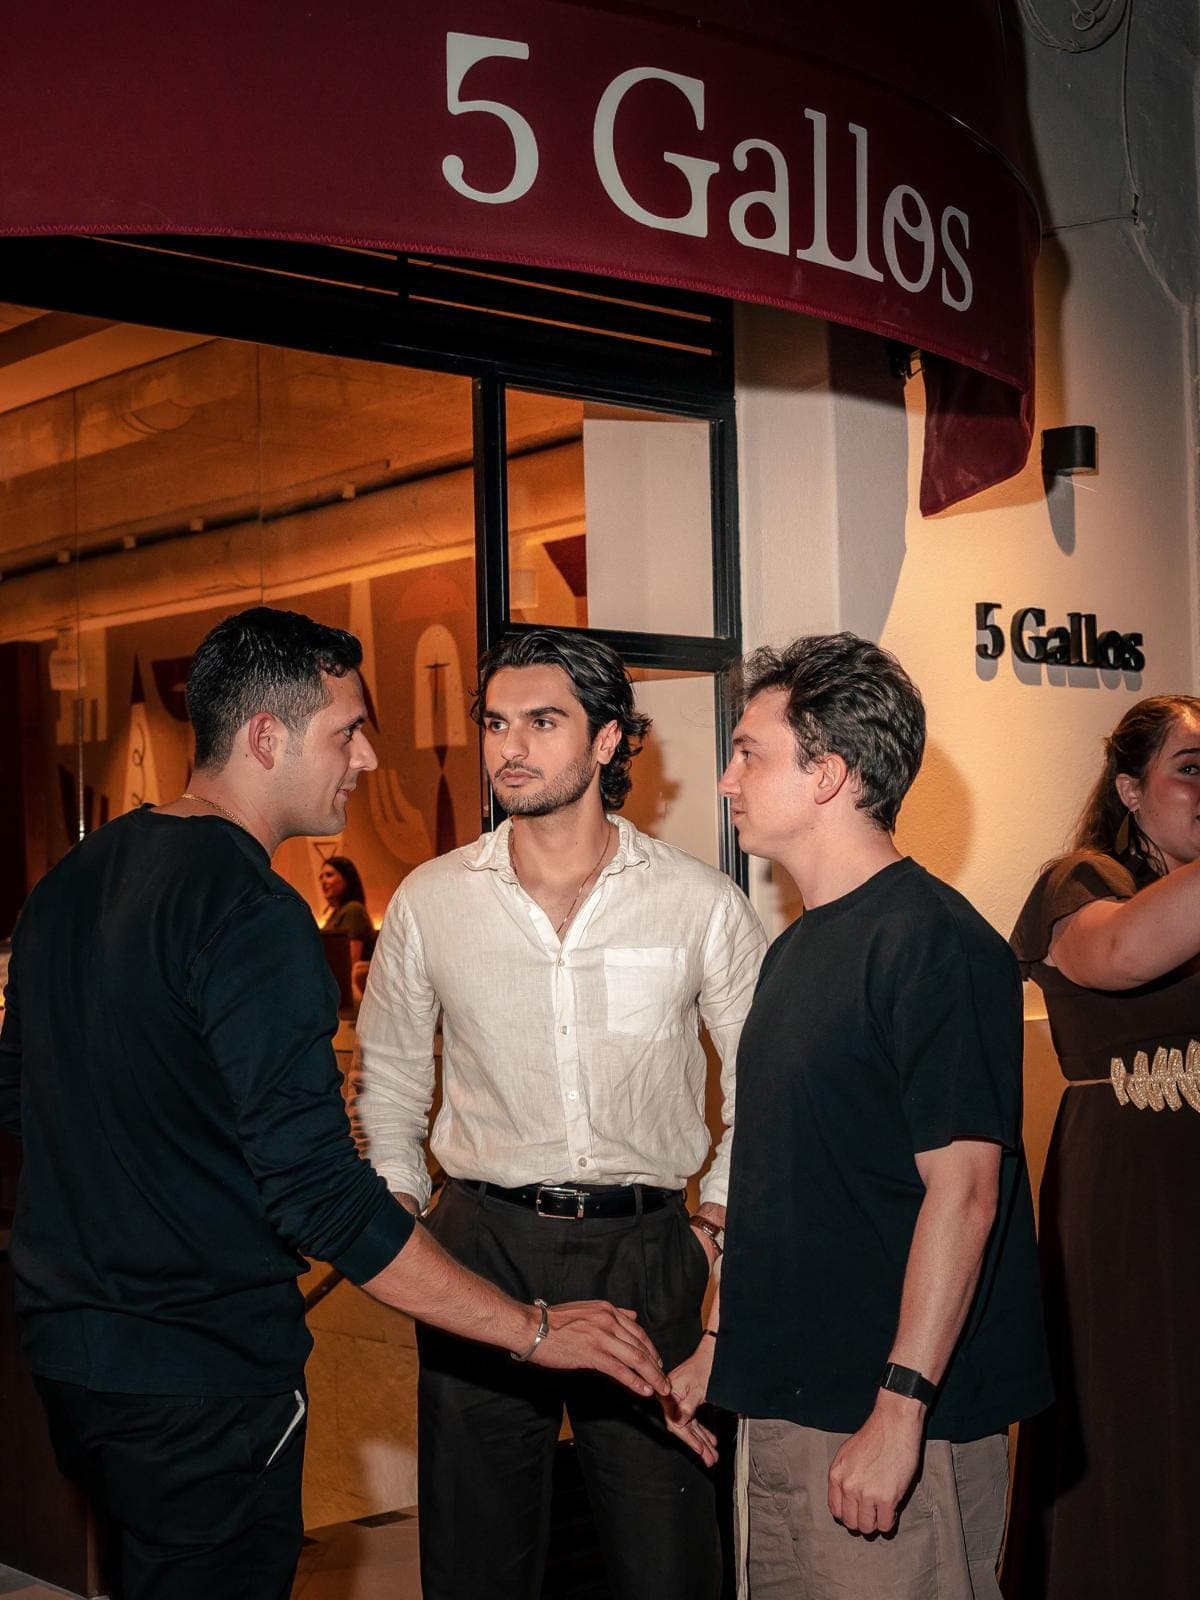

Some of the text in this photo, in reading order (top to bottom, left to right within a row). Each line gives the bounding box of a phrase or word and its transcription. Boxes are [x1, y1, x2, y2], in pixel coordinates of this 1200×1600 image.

[441, 31, 974, 312] 5 Gallos
[975, 602, 1146, 672] 5 Gallos
